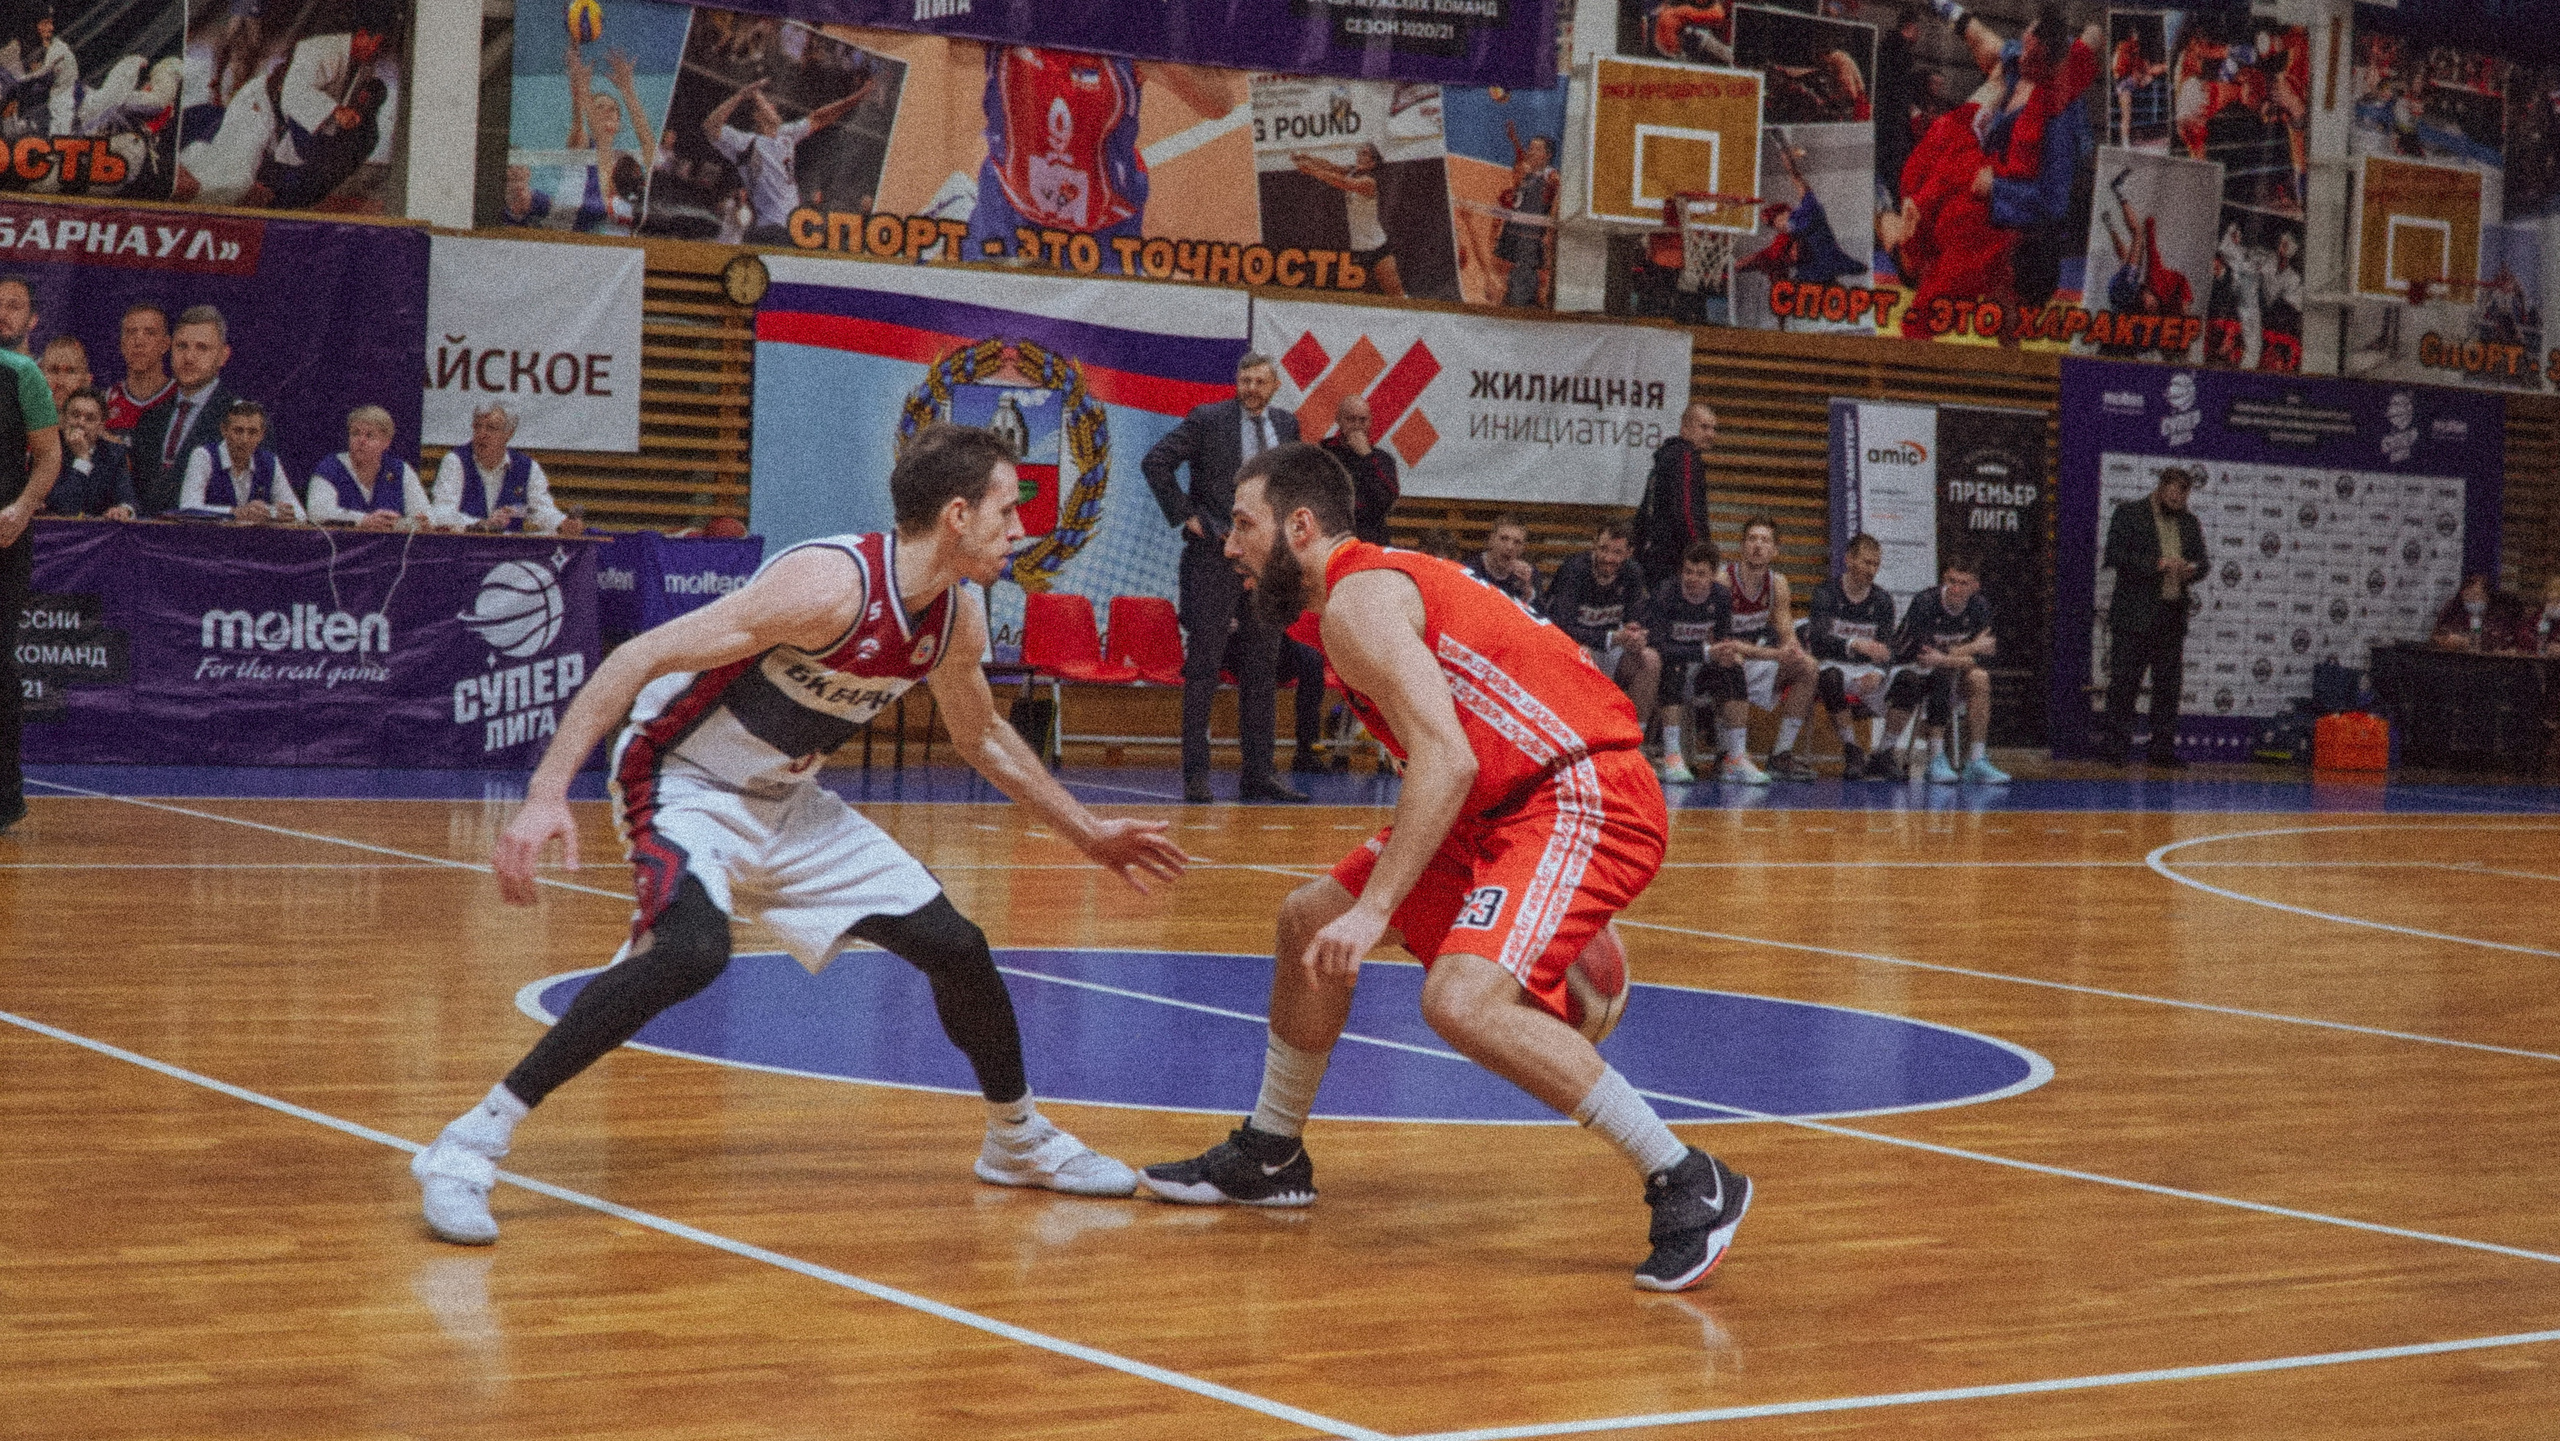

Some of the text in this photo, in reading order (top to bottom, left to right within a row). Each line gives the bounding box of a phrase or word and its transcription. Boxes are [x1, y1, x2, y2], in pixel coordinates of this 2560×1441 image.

[1345, 17, 1399, 34] СЕЗОН
[1275, 111, 1361, 139] POUND
[788, 208, 967, 262] СПОРТ
[1016, 228, 1099, 274] ЭТО
[1112, 237, 1366, 289] ТОЧНОСТЬ
[1770, 280, 1898, 328] СПОРТ
[1929, 299, 2003, 337] ЭТО
[2013, 305, 2201, 350] ХАРАКТЕР
[1867, 443, 1921, 466] amic
[1949, 479, 2037, 507] ПРЕМЬЕР
[1969, 507, 2019, 532] ЛИГА
[202, 602, 390, 652] molten
[194, 656, 391, 689] For the real game
[453, 652, 585, 725] СУПЕР
[484, 706, 557, 752] ЛИГА
